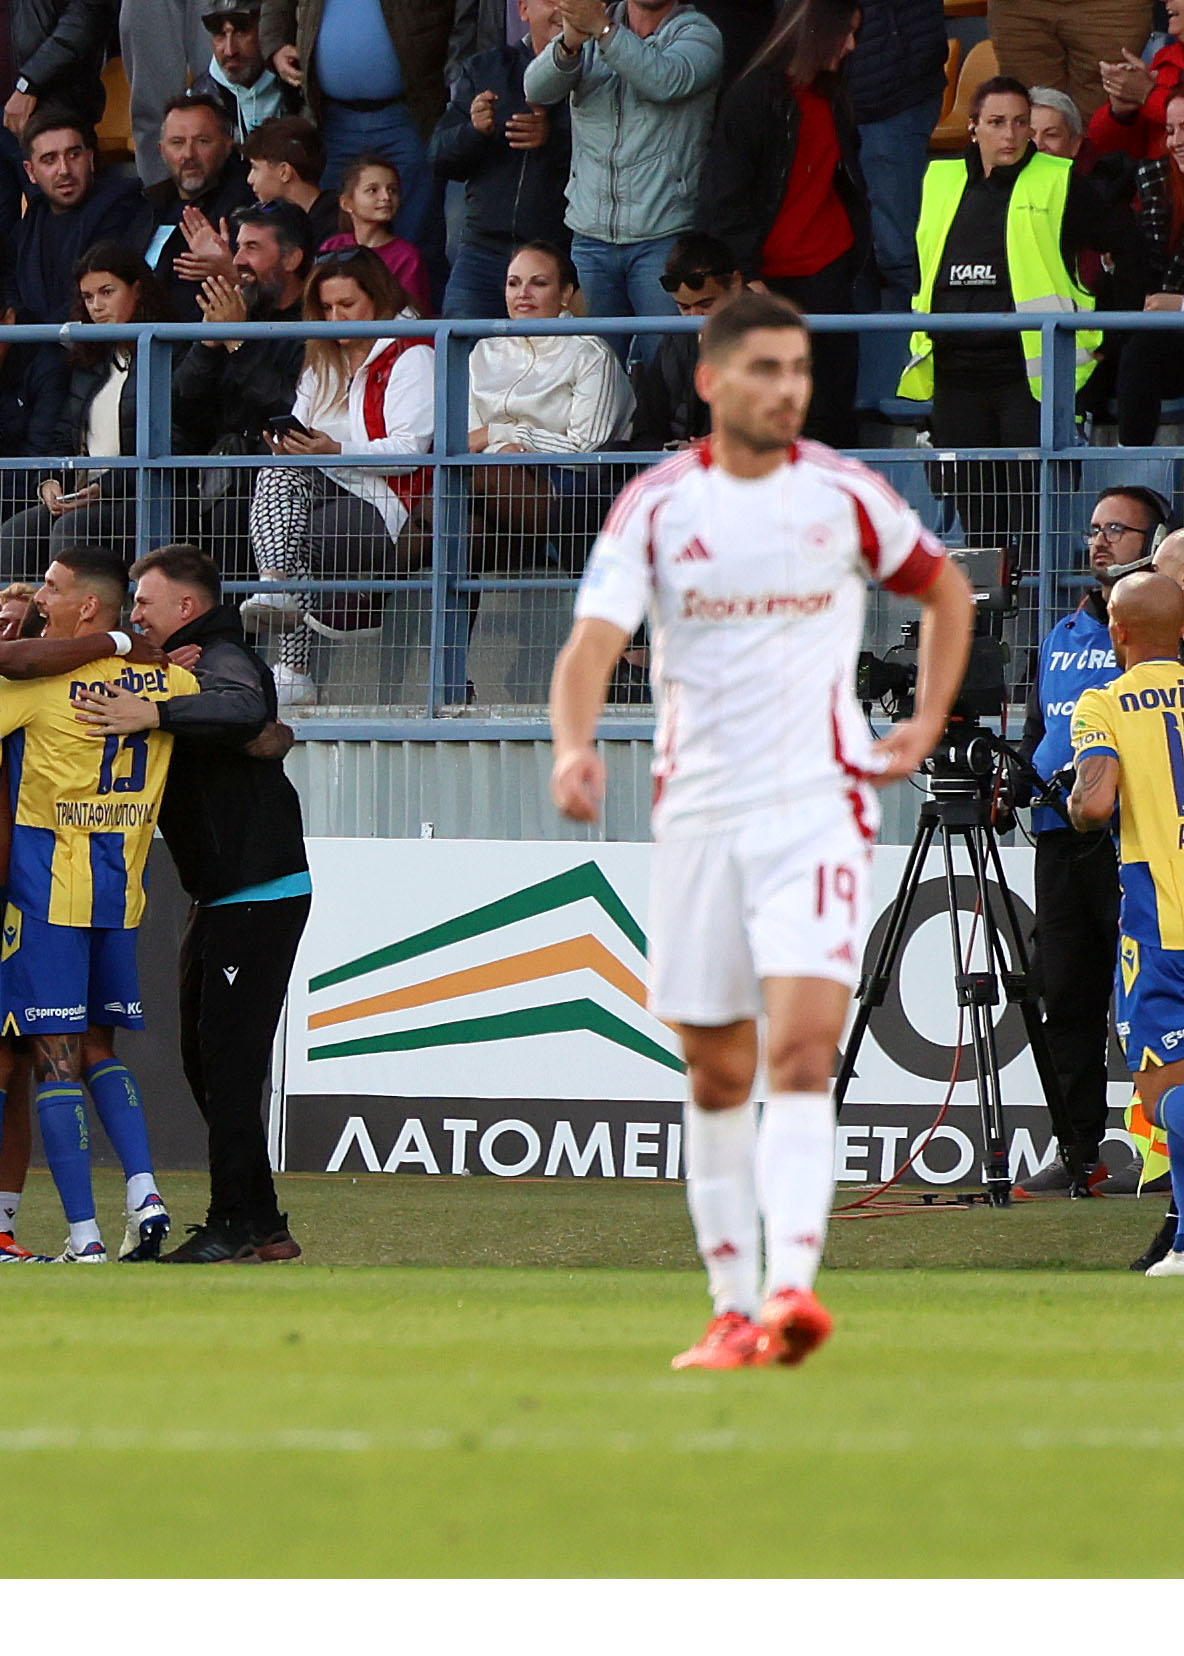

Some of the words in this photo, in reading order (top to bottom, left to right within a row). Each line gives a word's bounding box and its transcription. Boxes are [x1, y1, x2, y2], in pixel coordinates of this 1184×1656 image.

[949, 264, 997, 281] KARL
[1049, 651, 1077, 671] TV
[1077, 649, 1117, 670] CRE
[1119, 679, 1184, 712] novi
[814, 864, 856, 926] 19
[326, 1116, 682, 1179] ΛΑΤΟΜΕΙ
